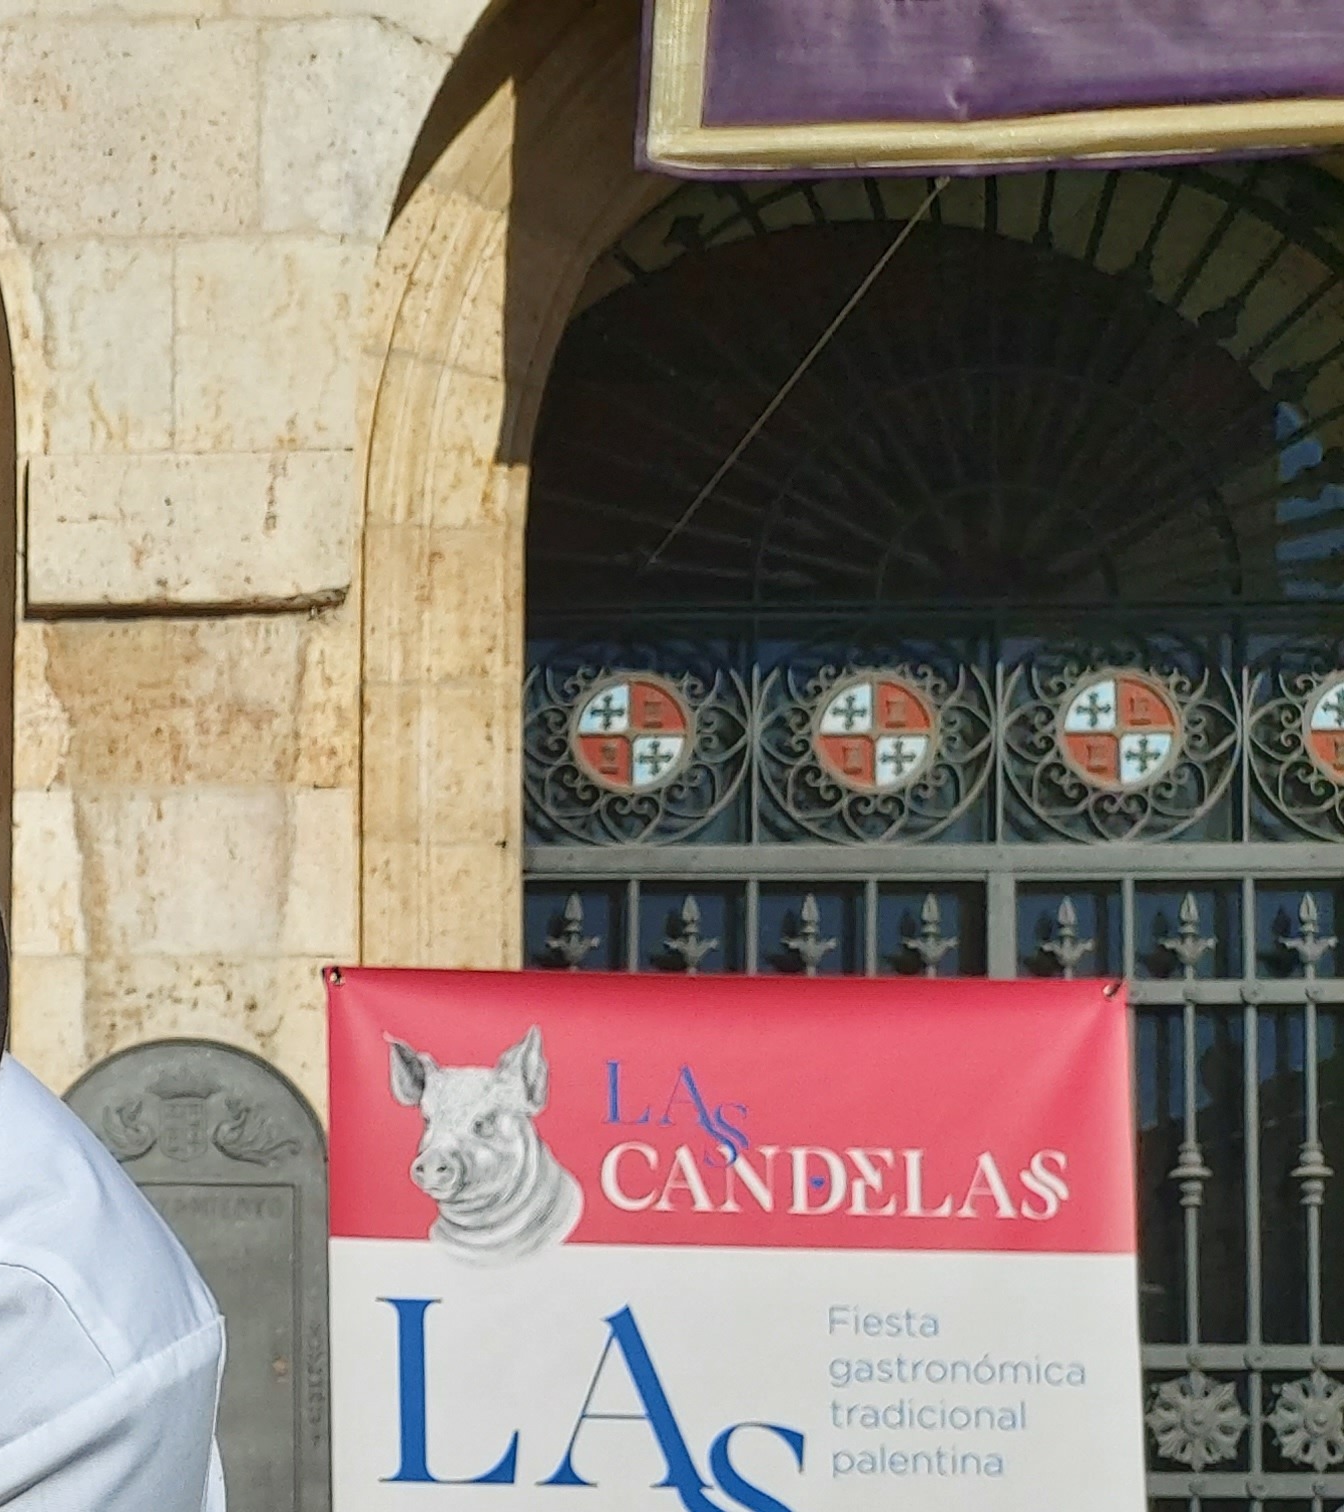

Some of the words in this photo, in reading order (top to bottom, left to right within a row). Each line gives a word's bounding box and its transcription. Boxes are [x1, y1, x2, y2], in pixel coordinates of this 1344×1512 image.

[602, 1060, 748, 1168] LAS
[601, 1141, 1069, 1221] CANDELAS
[828, 1304, 940, 1338] Fiesta
[829, 1353, 1086, 1388] gastronómica
[831, 1399, 1026, 1430] tradicional
[832, 1444, 1004, 1478] palentina
